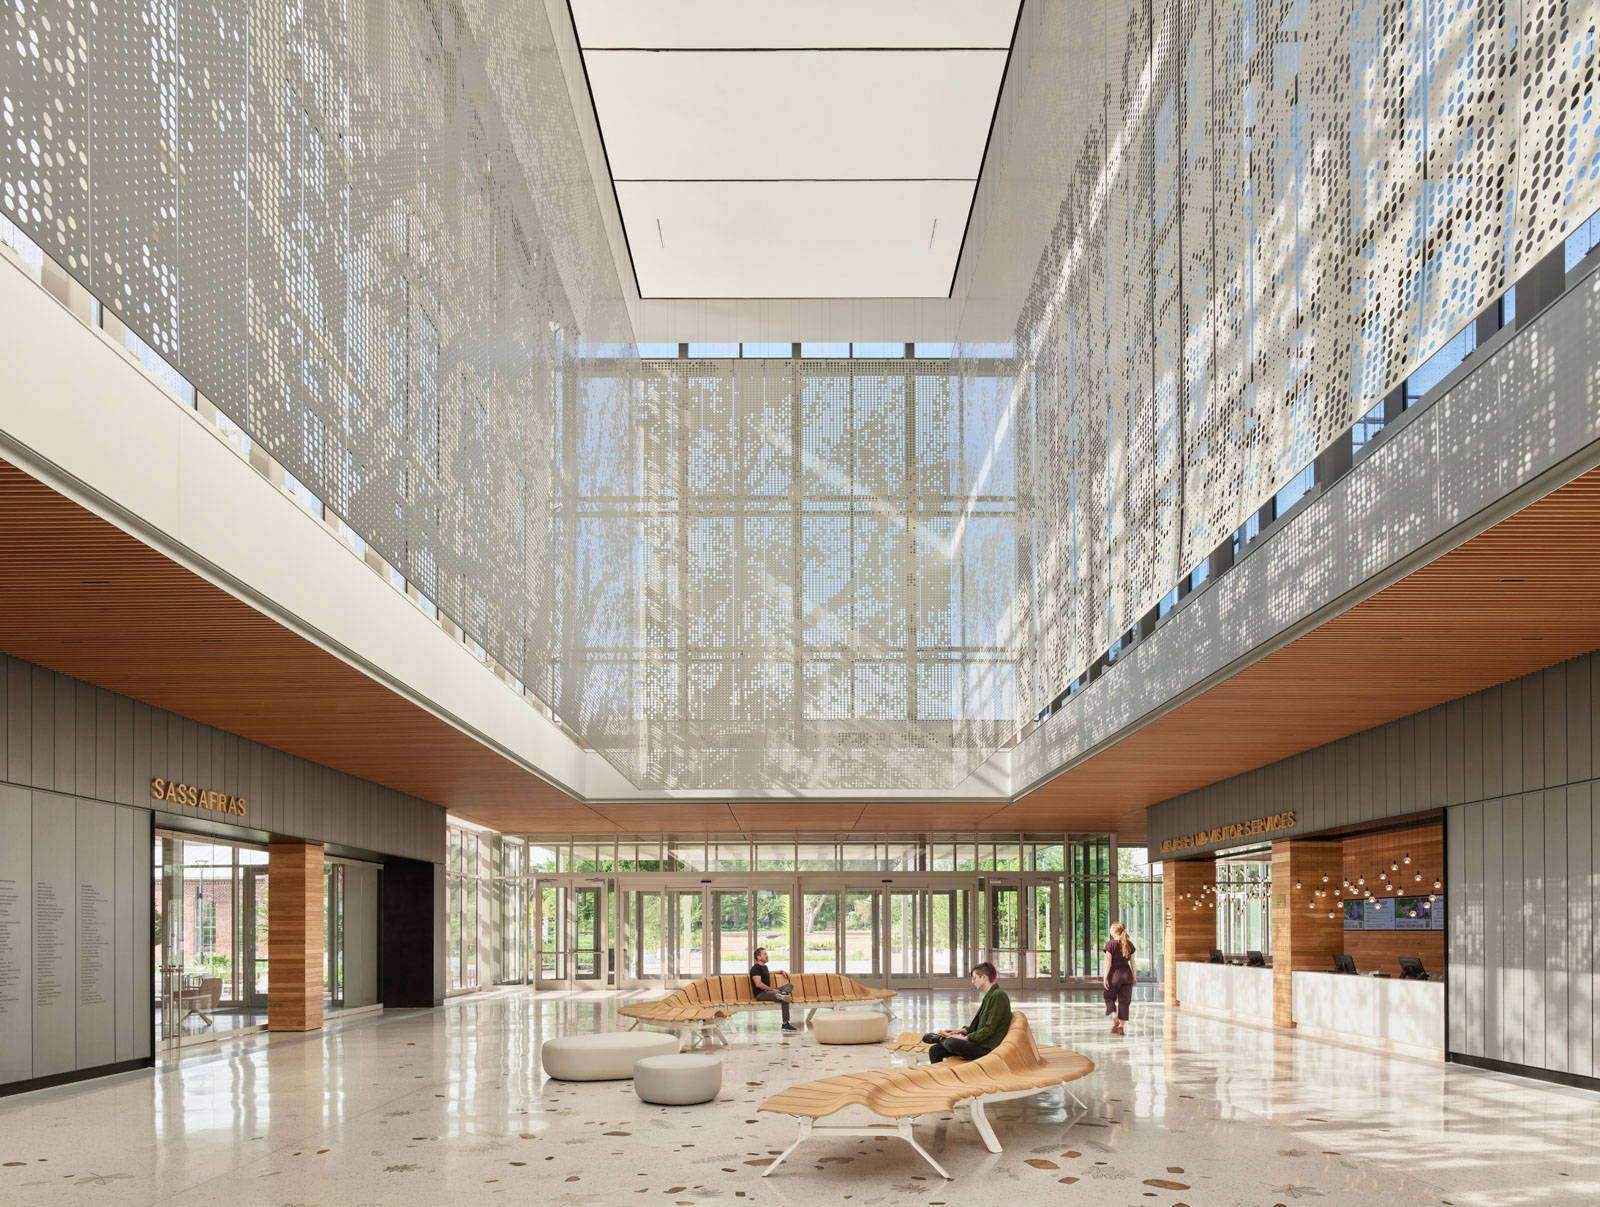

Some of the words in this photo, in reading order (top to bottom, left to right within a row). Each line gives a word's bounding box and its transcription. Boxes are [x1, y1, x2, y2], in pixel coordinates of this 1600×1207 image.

[152, 778, 246, 816] SASSAFRAS
[1191, 832, 1208, 847] AND
[1208, 823, 1244, 844] VISITOR
[1245, 811, 1296, 836] SERVICES
